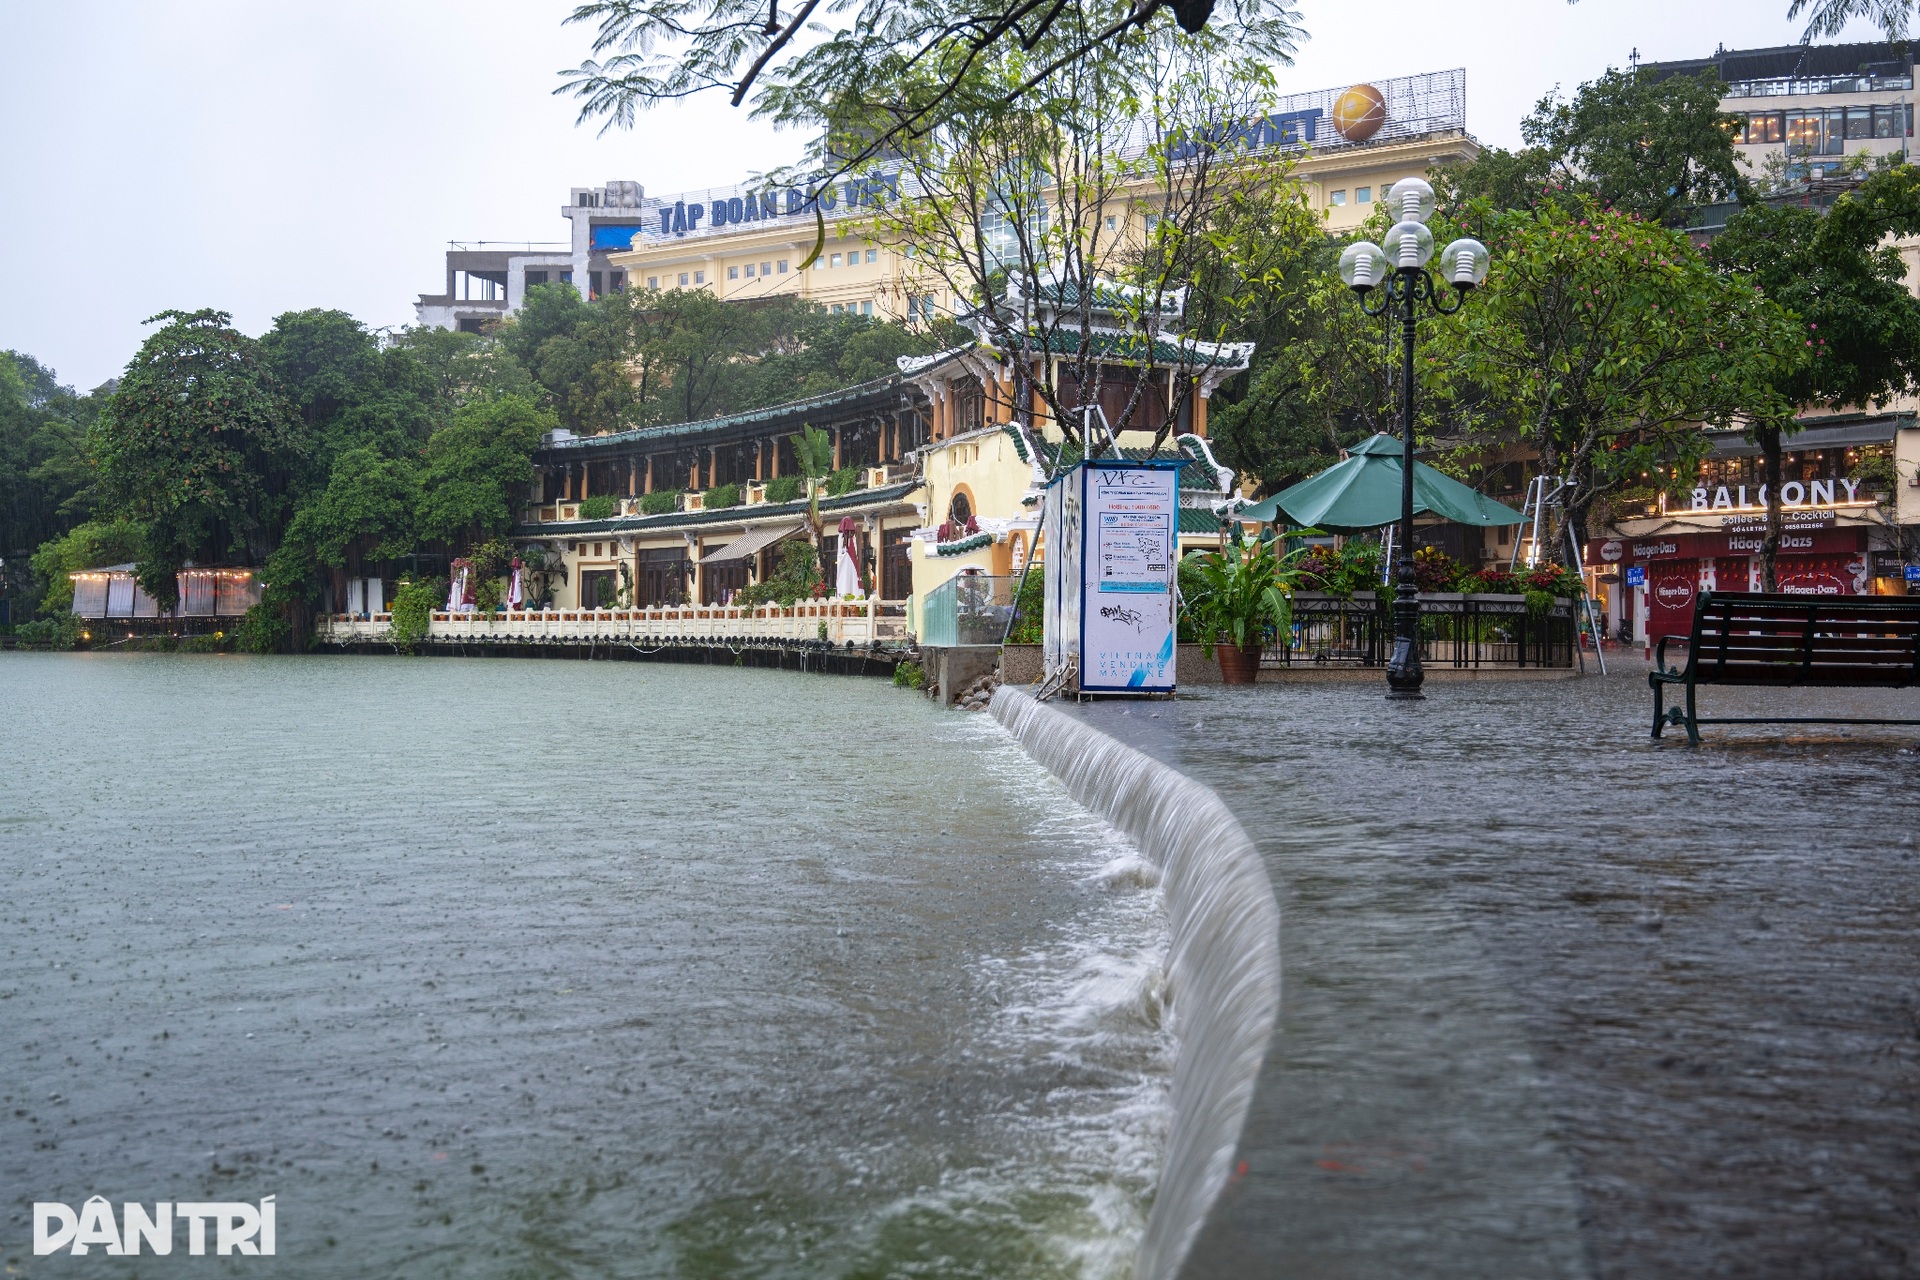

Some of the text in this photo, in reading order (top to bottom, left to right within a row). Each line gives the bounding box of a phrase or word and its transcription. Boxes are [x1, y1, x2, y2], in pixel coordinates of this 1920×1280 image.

[659, 200, 704, 237] TẬP
[1720, 514, 1753, 525] Coffee
[1792, 510, 1835, 521] Cocktail
[1729, 534, 1813, 553] Häag-Dazs
[1633, 542, 1676, 559] Häagen-Dazs
[1659, 586, 1689, 598] Häagen-Dazs
[1099, 652, 1164, 660] VIETNAM
[1099, 660, 1165, 669] VENDING
[1099, 670, 1164, 678] MACINE
